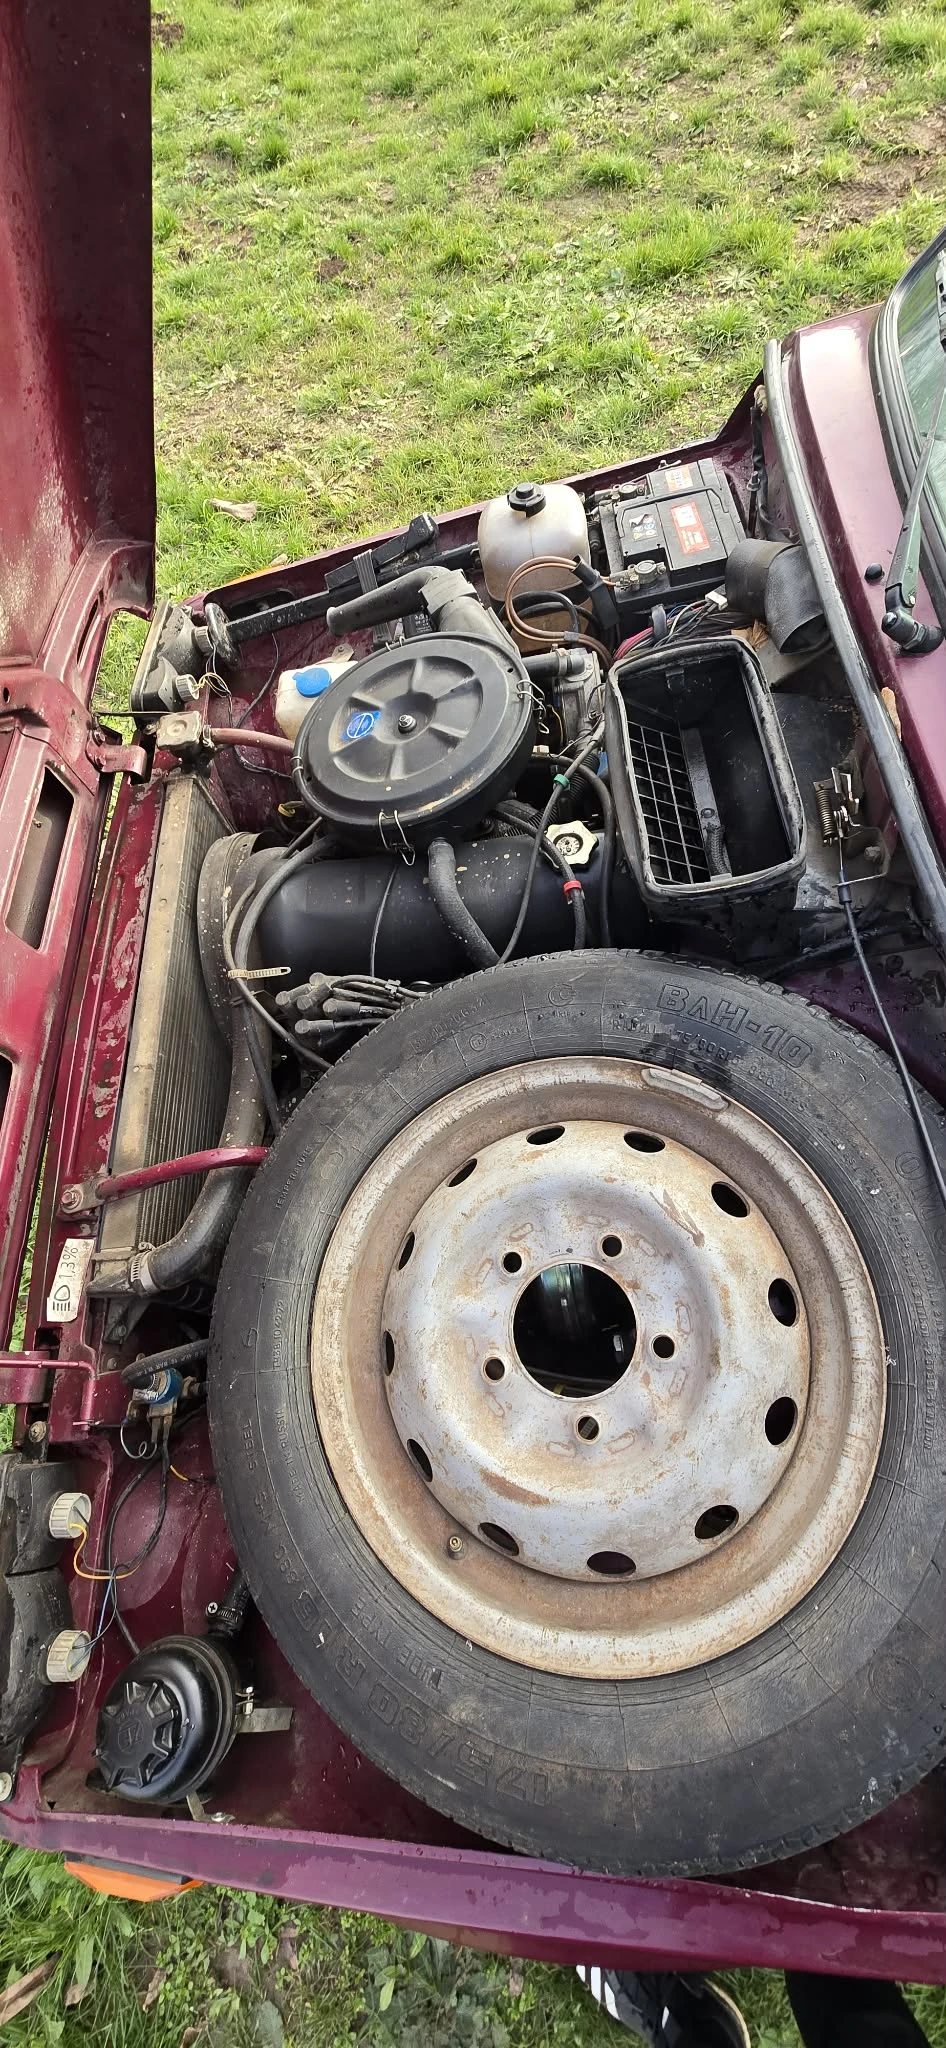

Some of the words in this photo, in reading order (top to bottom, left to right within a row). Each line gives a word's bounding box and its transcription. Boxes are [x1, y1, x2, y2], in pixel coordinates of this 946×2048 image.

[242, 1418, 258, 1471] STEEL
[274, 1407, 290, 1449] RUSSIA
[285, 1468, 305, 1503] MADE
[351, 1597, 394, 1649] TYPE
